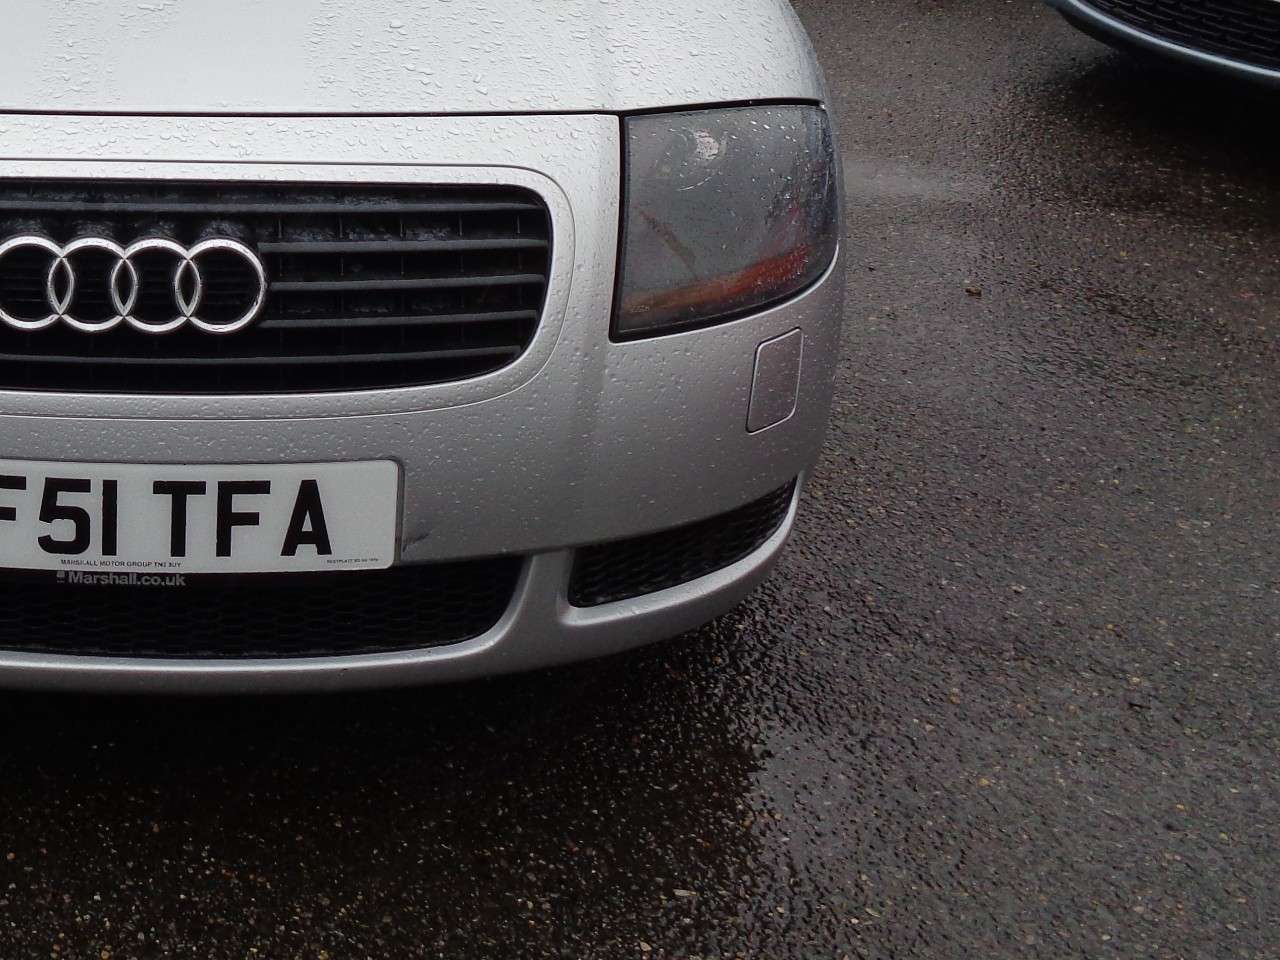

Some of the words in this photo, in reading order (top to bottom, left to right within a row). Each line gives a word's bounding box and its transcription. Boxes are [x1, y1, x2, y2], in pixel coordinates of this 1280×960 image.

[152, 478, 332, 557] TFA
[60, 559, 98, 567] MARSHALL
[99, 560, 125, 568] MOTOR
[68, 570, 186, 587] Marshall.co.uk
